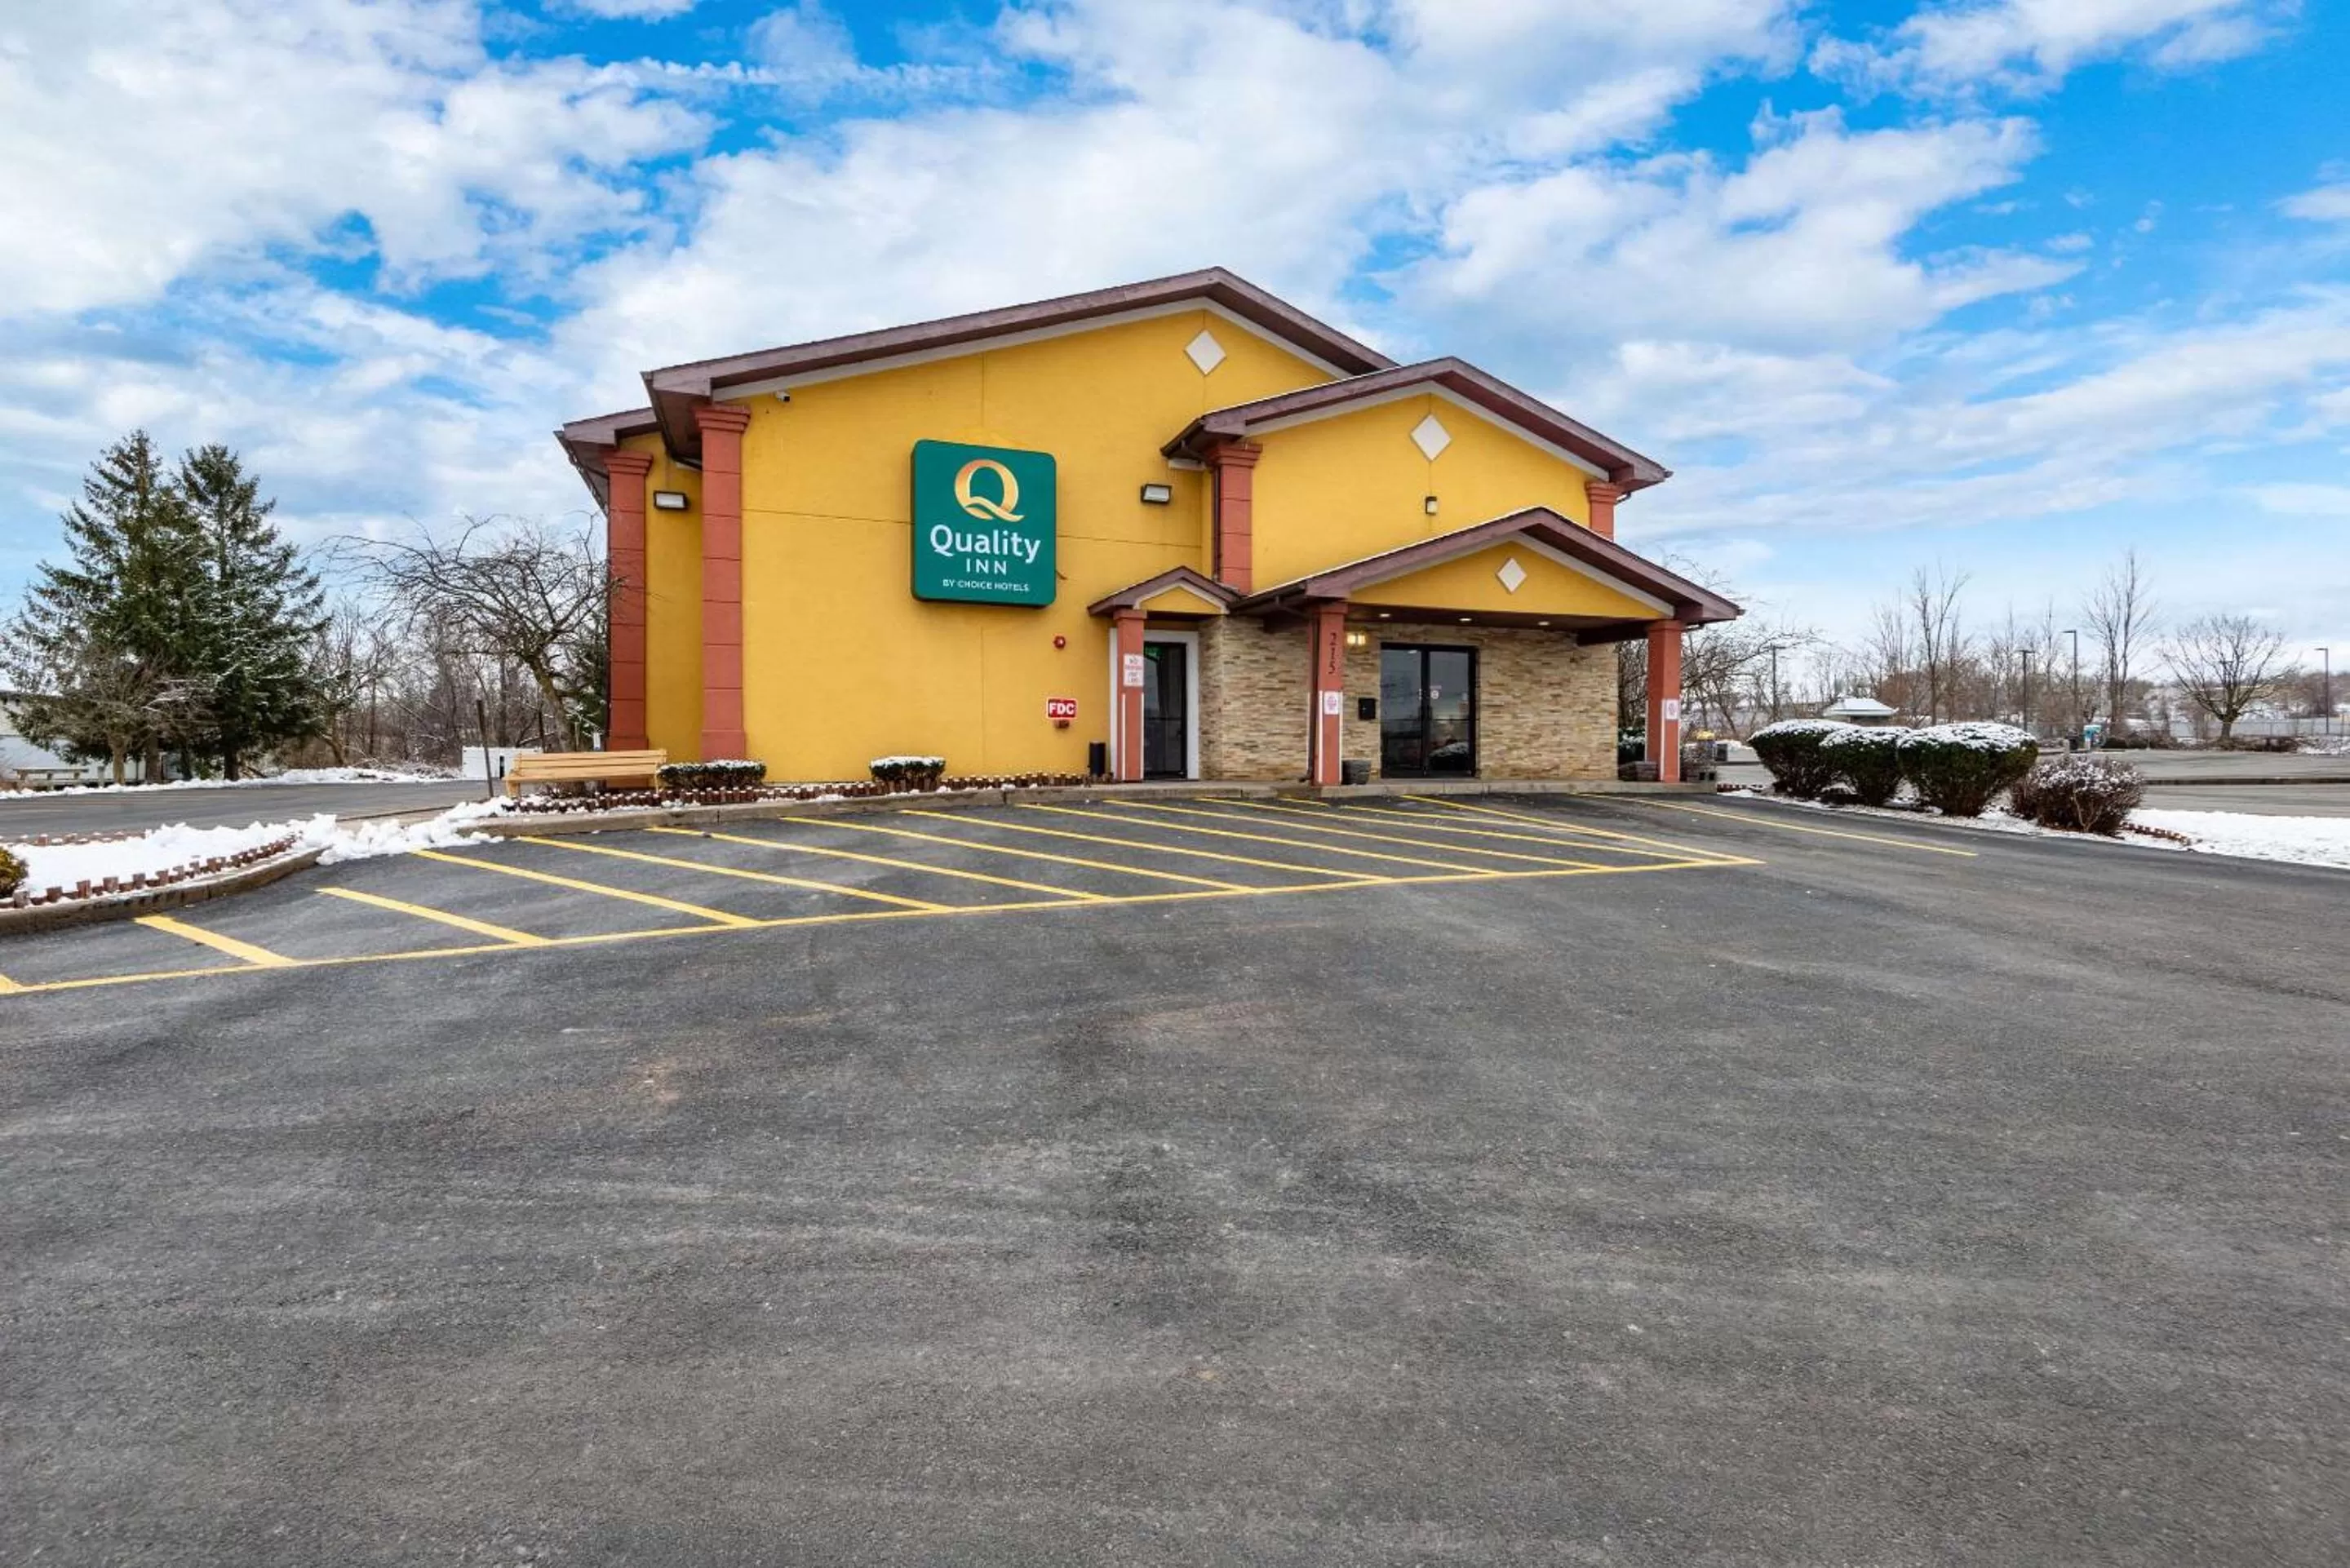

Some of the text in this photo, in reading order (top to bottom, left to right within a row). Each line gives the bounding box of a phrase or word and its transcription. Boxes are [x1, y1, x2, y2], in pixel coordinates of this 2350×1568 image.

[954, 458, 1025, 522] Q
[929, 524, 1041, 565] Quality
[966, 558, 1008, 575] INN
[942, 578, 1030, 591] BY CHOICE HOTELS
[1049, 702, 1075, 715] FDC
